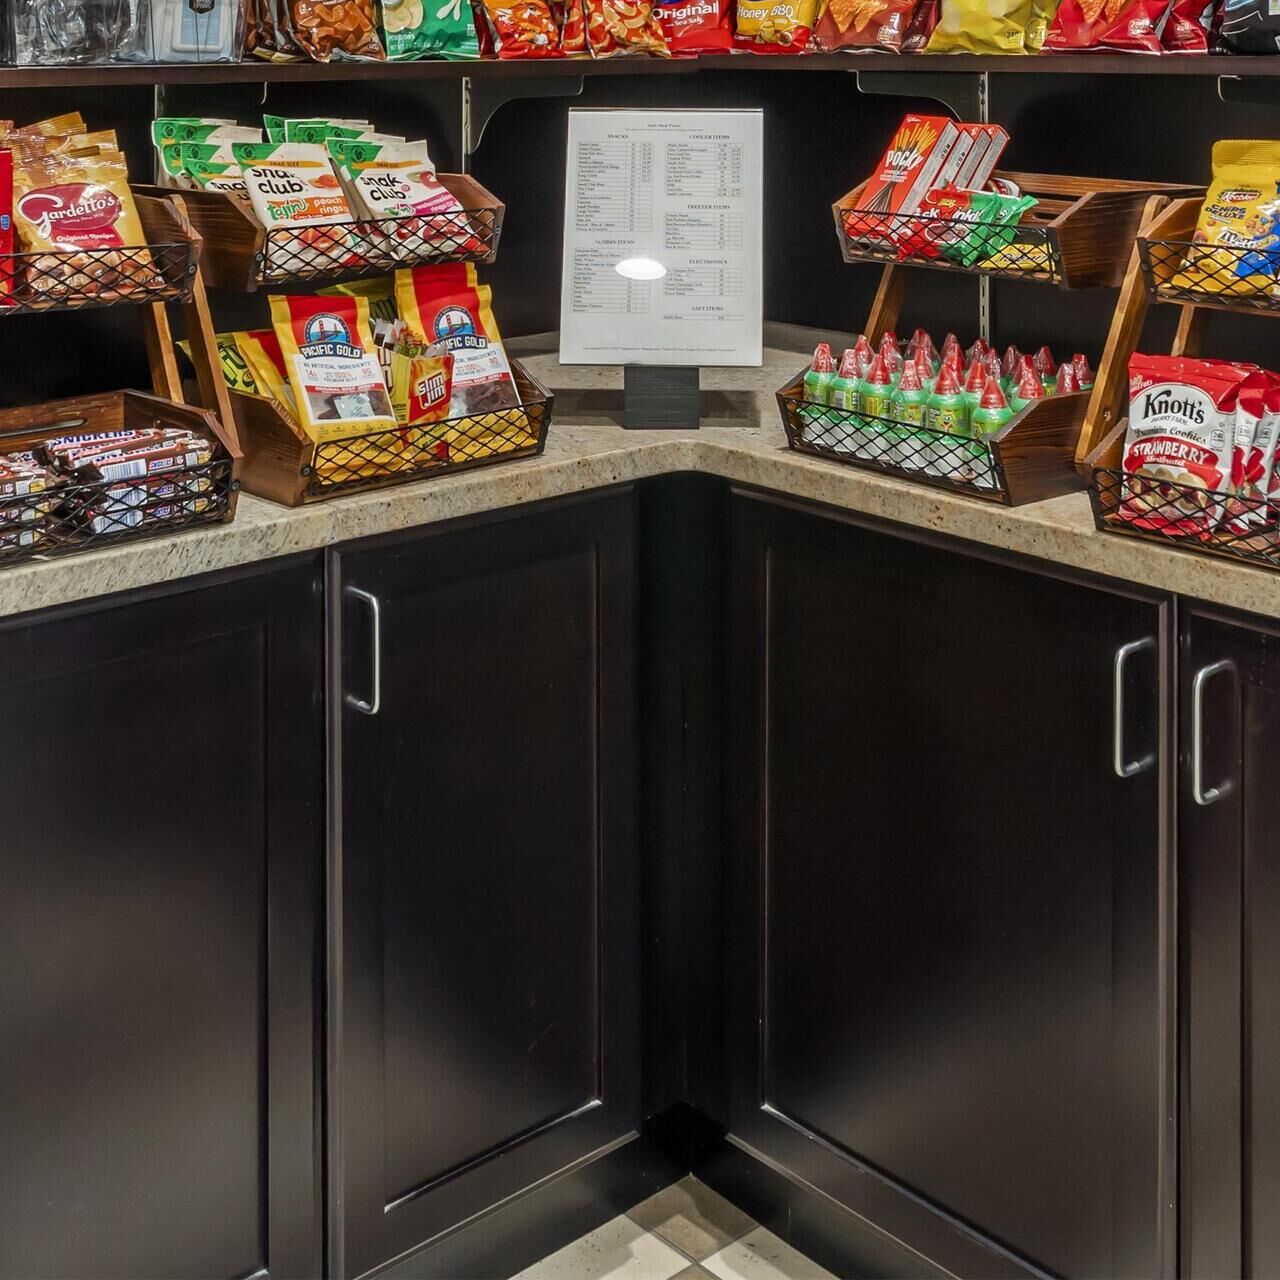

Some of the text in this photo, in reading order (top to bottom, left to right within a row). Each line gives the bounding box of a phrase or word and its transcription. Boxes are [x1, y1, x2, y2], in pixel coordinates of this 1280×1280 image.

[652, 1, 719, 20] Original
[738, 4, 794, 21] Honey BBQ
[885, 150, 924, 169] POCKY
[258, 178, 304, 195] club
[361, 173, 403, 186] snak
[314, 196, 343, 208] peach
[370, 187, 407, 201] club
[17, 193, 116, 239] Gardetto's
[320, 205, 343, 216] rings
[1205, 207, 1246, 220] DELUXE
[1211, 204, 1247, 215] CHIPS
[302, 344, 361, 359] PACIFIC GOLD
[1143, 389, 1205, 424] Knott's
[53, 430, 134, 446] SNICKERS
[1133, 442, 1210, 465] STRAWBERRY
